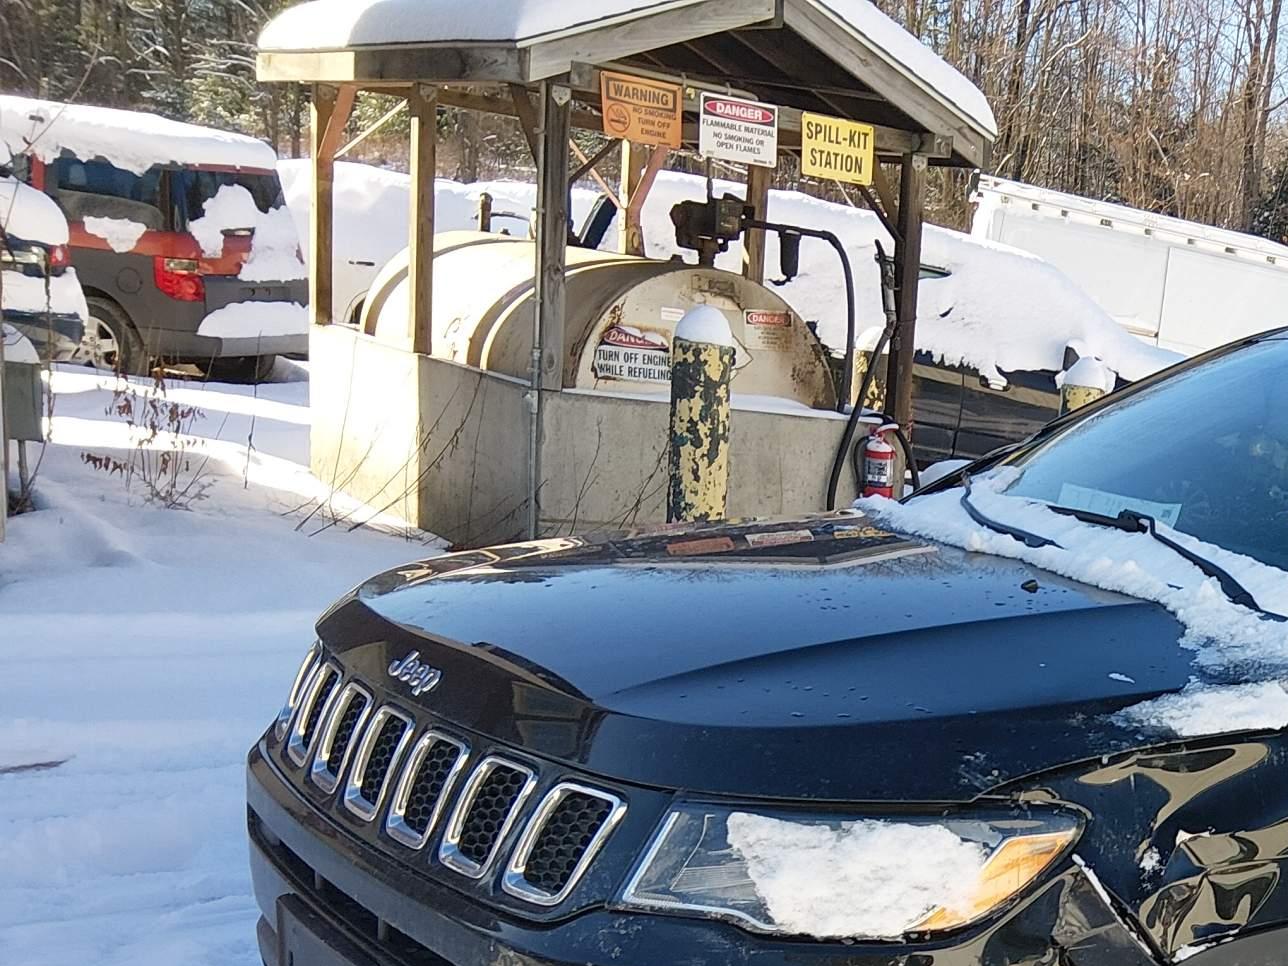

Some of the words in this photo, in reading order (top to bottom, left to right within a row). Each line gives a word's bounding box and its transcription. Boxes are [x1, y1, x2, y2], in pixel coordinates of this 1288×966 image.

[613, 82, 669, 106] WARNING
[632, 106, 643, 114] NO
[644, 107, 677, 121] SMOKING
[716, 102, 763, 121] DANGER
[638, 117, 656, 127] TURN
[656, 120, 671, 129] OFF
[703, 118, 742, 132] FLAMMABLE
[744, 126, 775, 137] MATERIAL
[640, 127, 667, 139] ENGINE
[712, 131, 723, 139] NO
[724, 132, 754, 145] SMOKING
[806, 120, 870, 150] SPILL-KIT
[716, 140, 734, 150] OPEN
[735, 143, 761, 155] FLAMES
[810, 147, 863, 175] STATION
[597, 349, 620, 362] TURN
[623, 351, 639, 364] OFF
[642, 353, 672, 368] ENGINE
[597, 362, 625, 377] WHILE
[627, 366, 673, 381] REFUELING
[388, 650, 441, 697] Jeep
